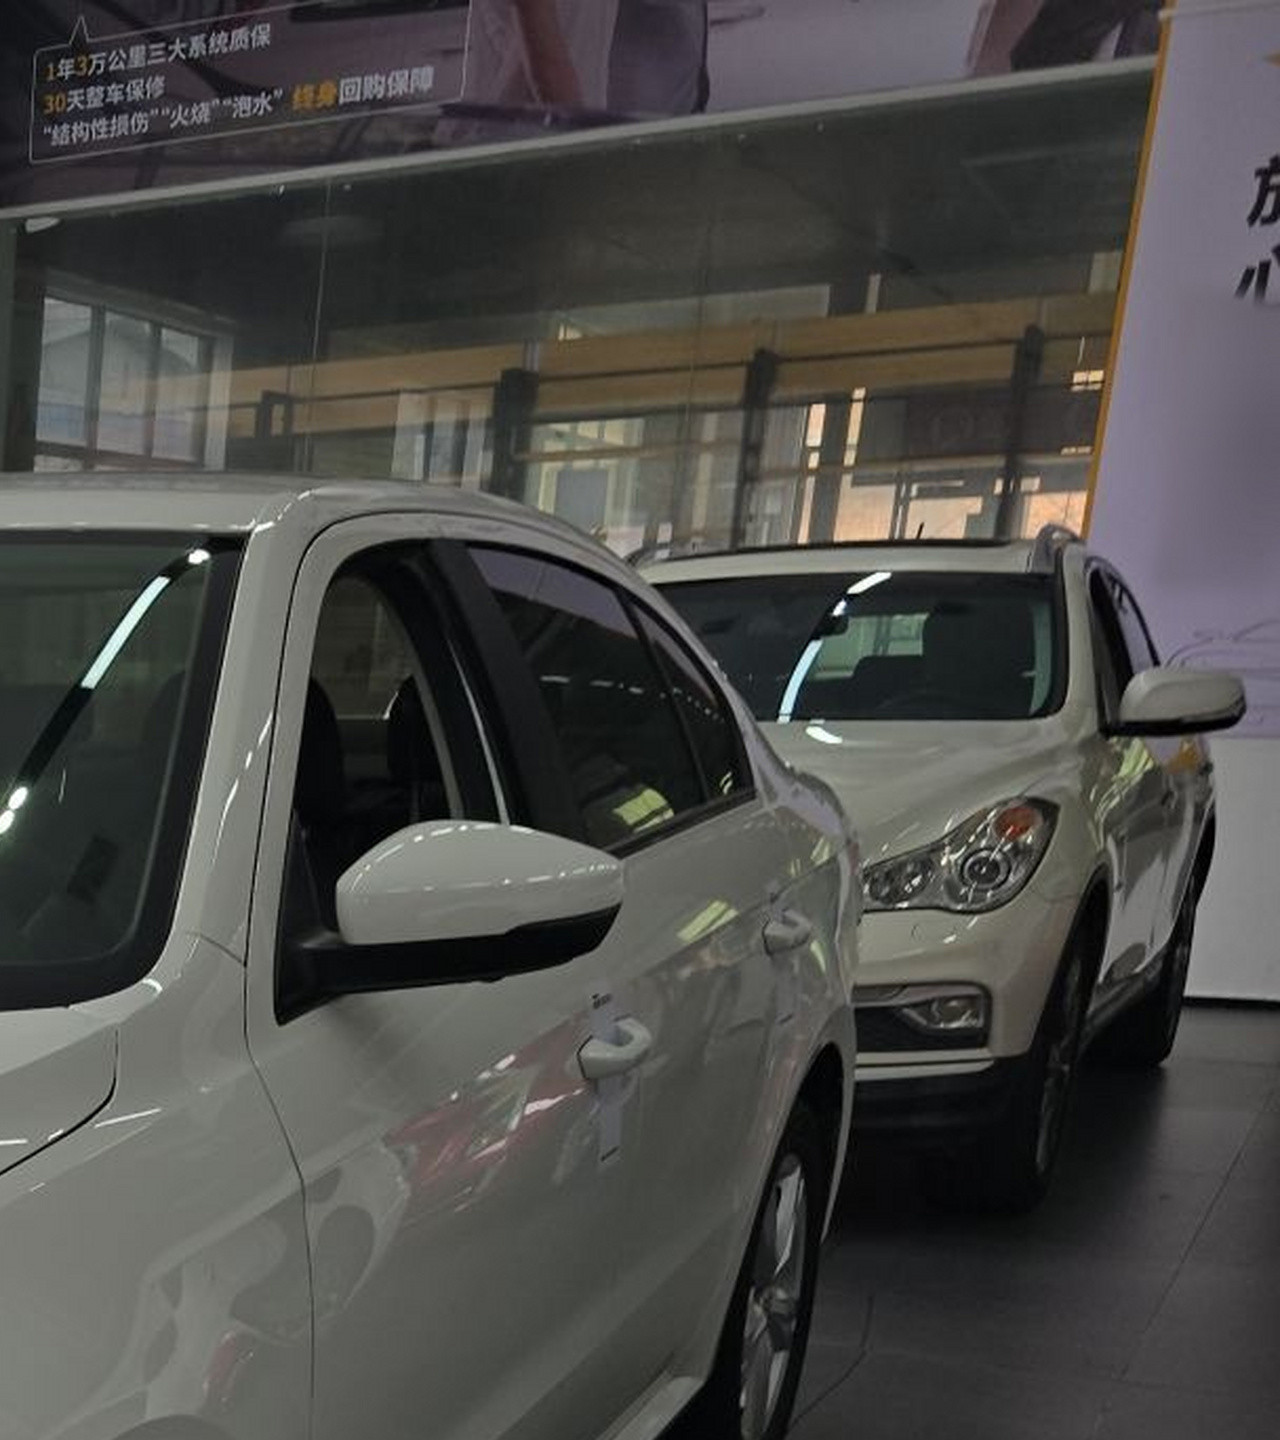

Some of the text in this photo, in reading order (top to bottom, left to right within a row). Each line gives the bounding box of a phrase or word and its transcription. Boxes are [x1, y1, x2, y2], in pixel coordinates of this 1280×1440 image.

[45, 22, 271, 82] 1年3万公里三大系统质保
[43, 75, 166, 114] 30天整车保修
